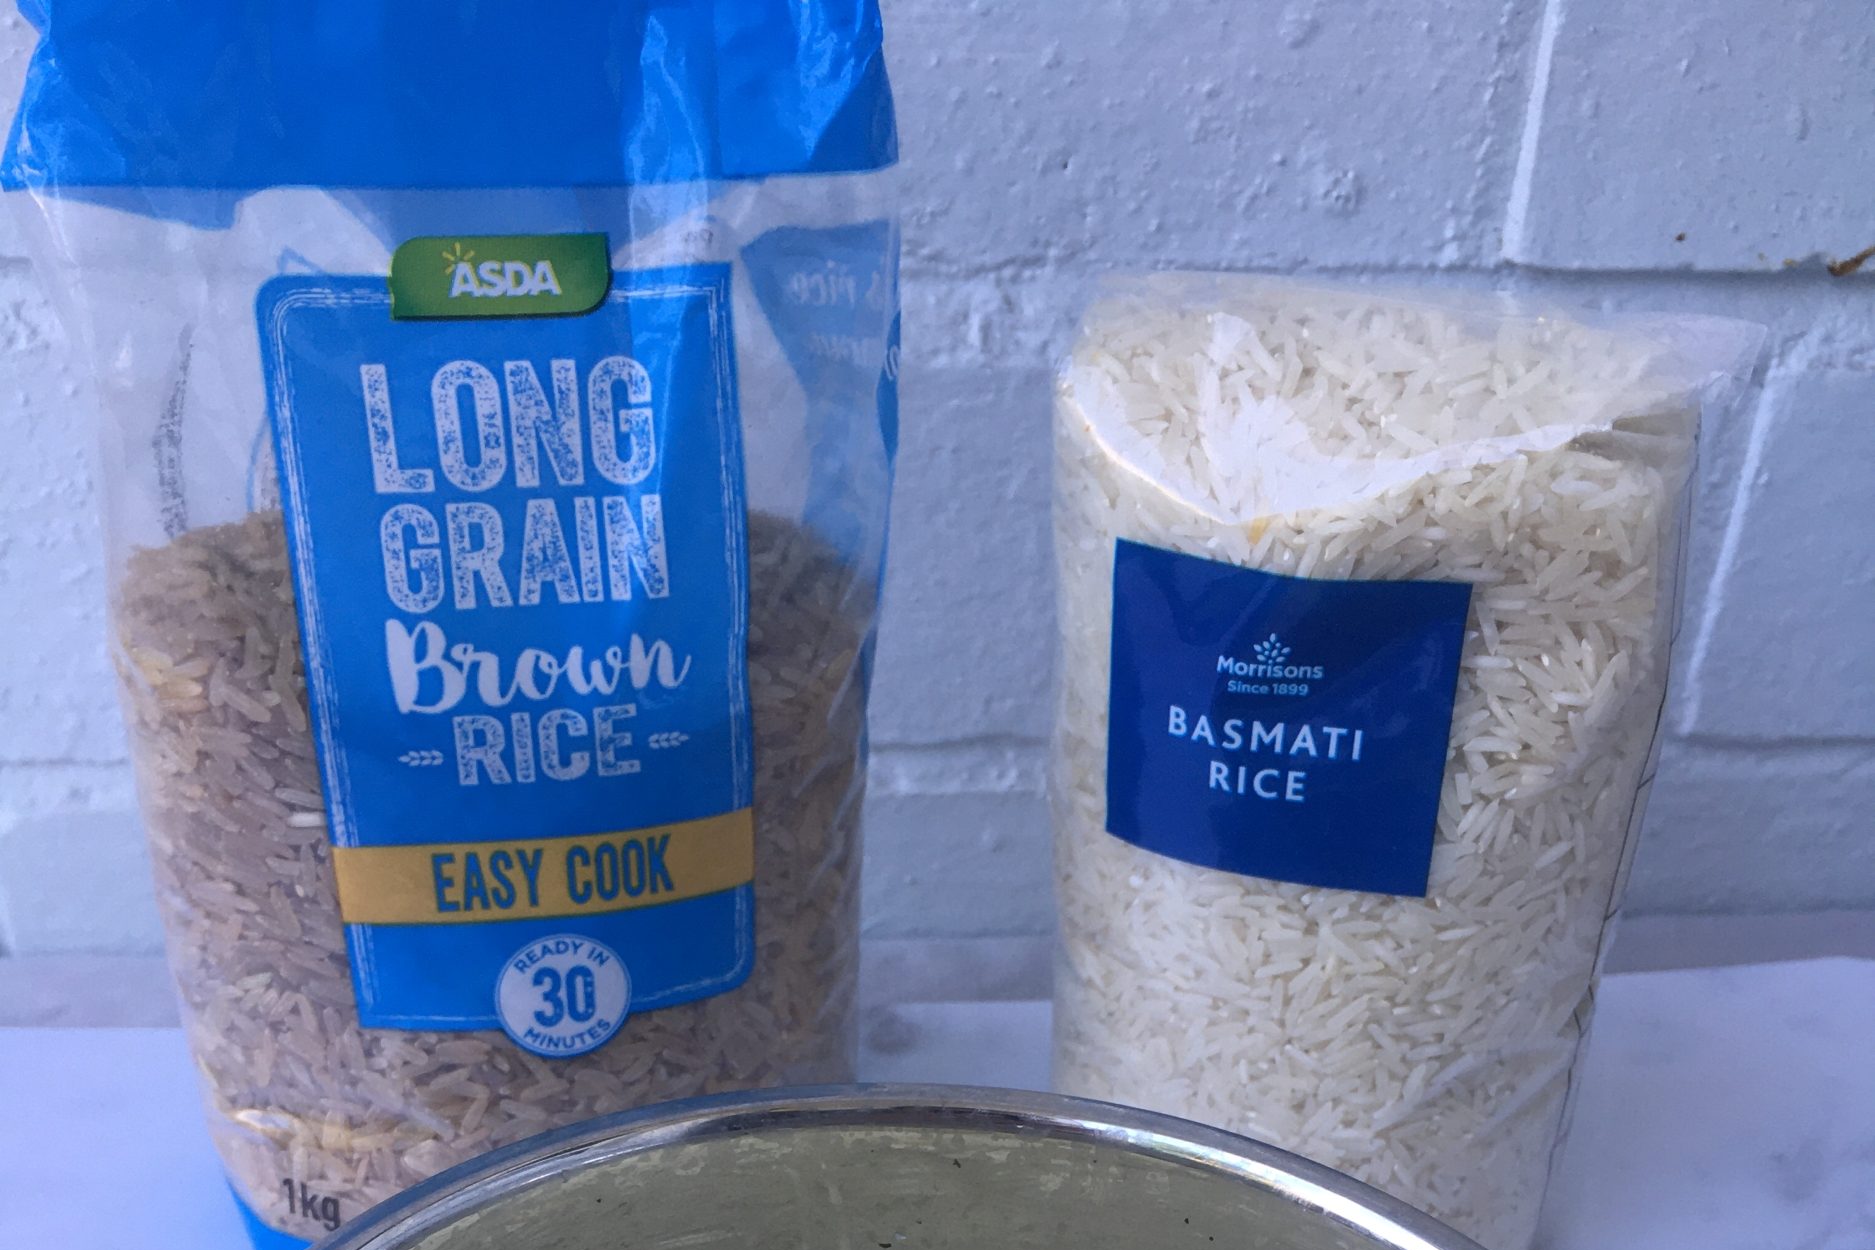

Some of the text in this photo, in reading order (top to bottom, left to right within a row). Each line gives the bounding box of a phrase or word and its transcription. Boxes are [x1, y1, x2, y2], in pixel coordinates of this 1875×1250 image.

[447, 260, 563, 298] ASDA
[359, 355, 657, 494] LONG
[379, 494, 670, 614] GRAIN
[384, 617, 692, 715] Brown
[1216, 655, 1325, 679] Morrisons
[1227, 680, 1310, 696] Since 1899
[452, 703, 642, 786] RICE
[1168, 704, 1365, 761] BASMATI
[1208, 760, 1308, 802] RICE
[432, 834, 675, 913] EASY COOK
[513, 940, 611, 975] READY IN
[533, 965, 596, 1028] 30
[524, 1018, 611, 1050] MINUTES
[283, 1178, 341, 1232] 1kg
